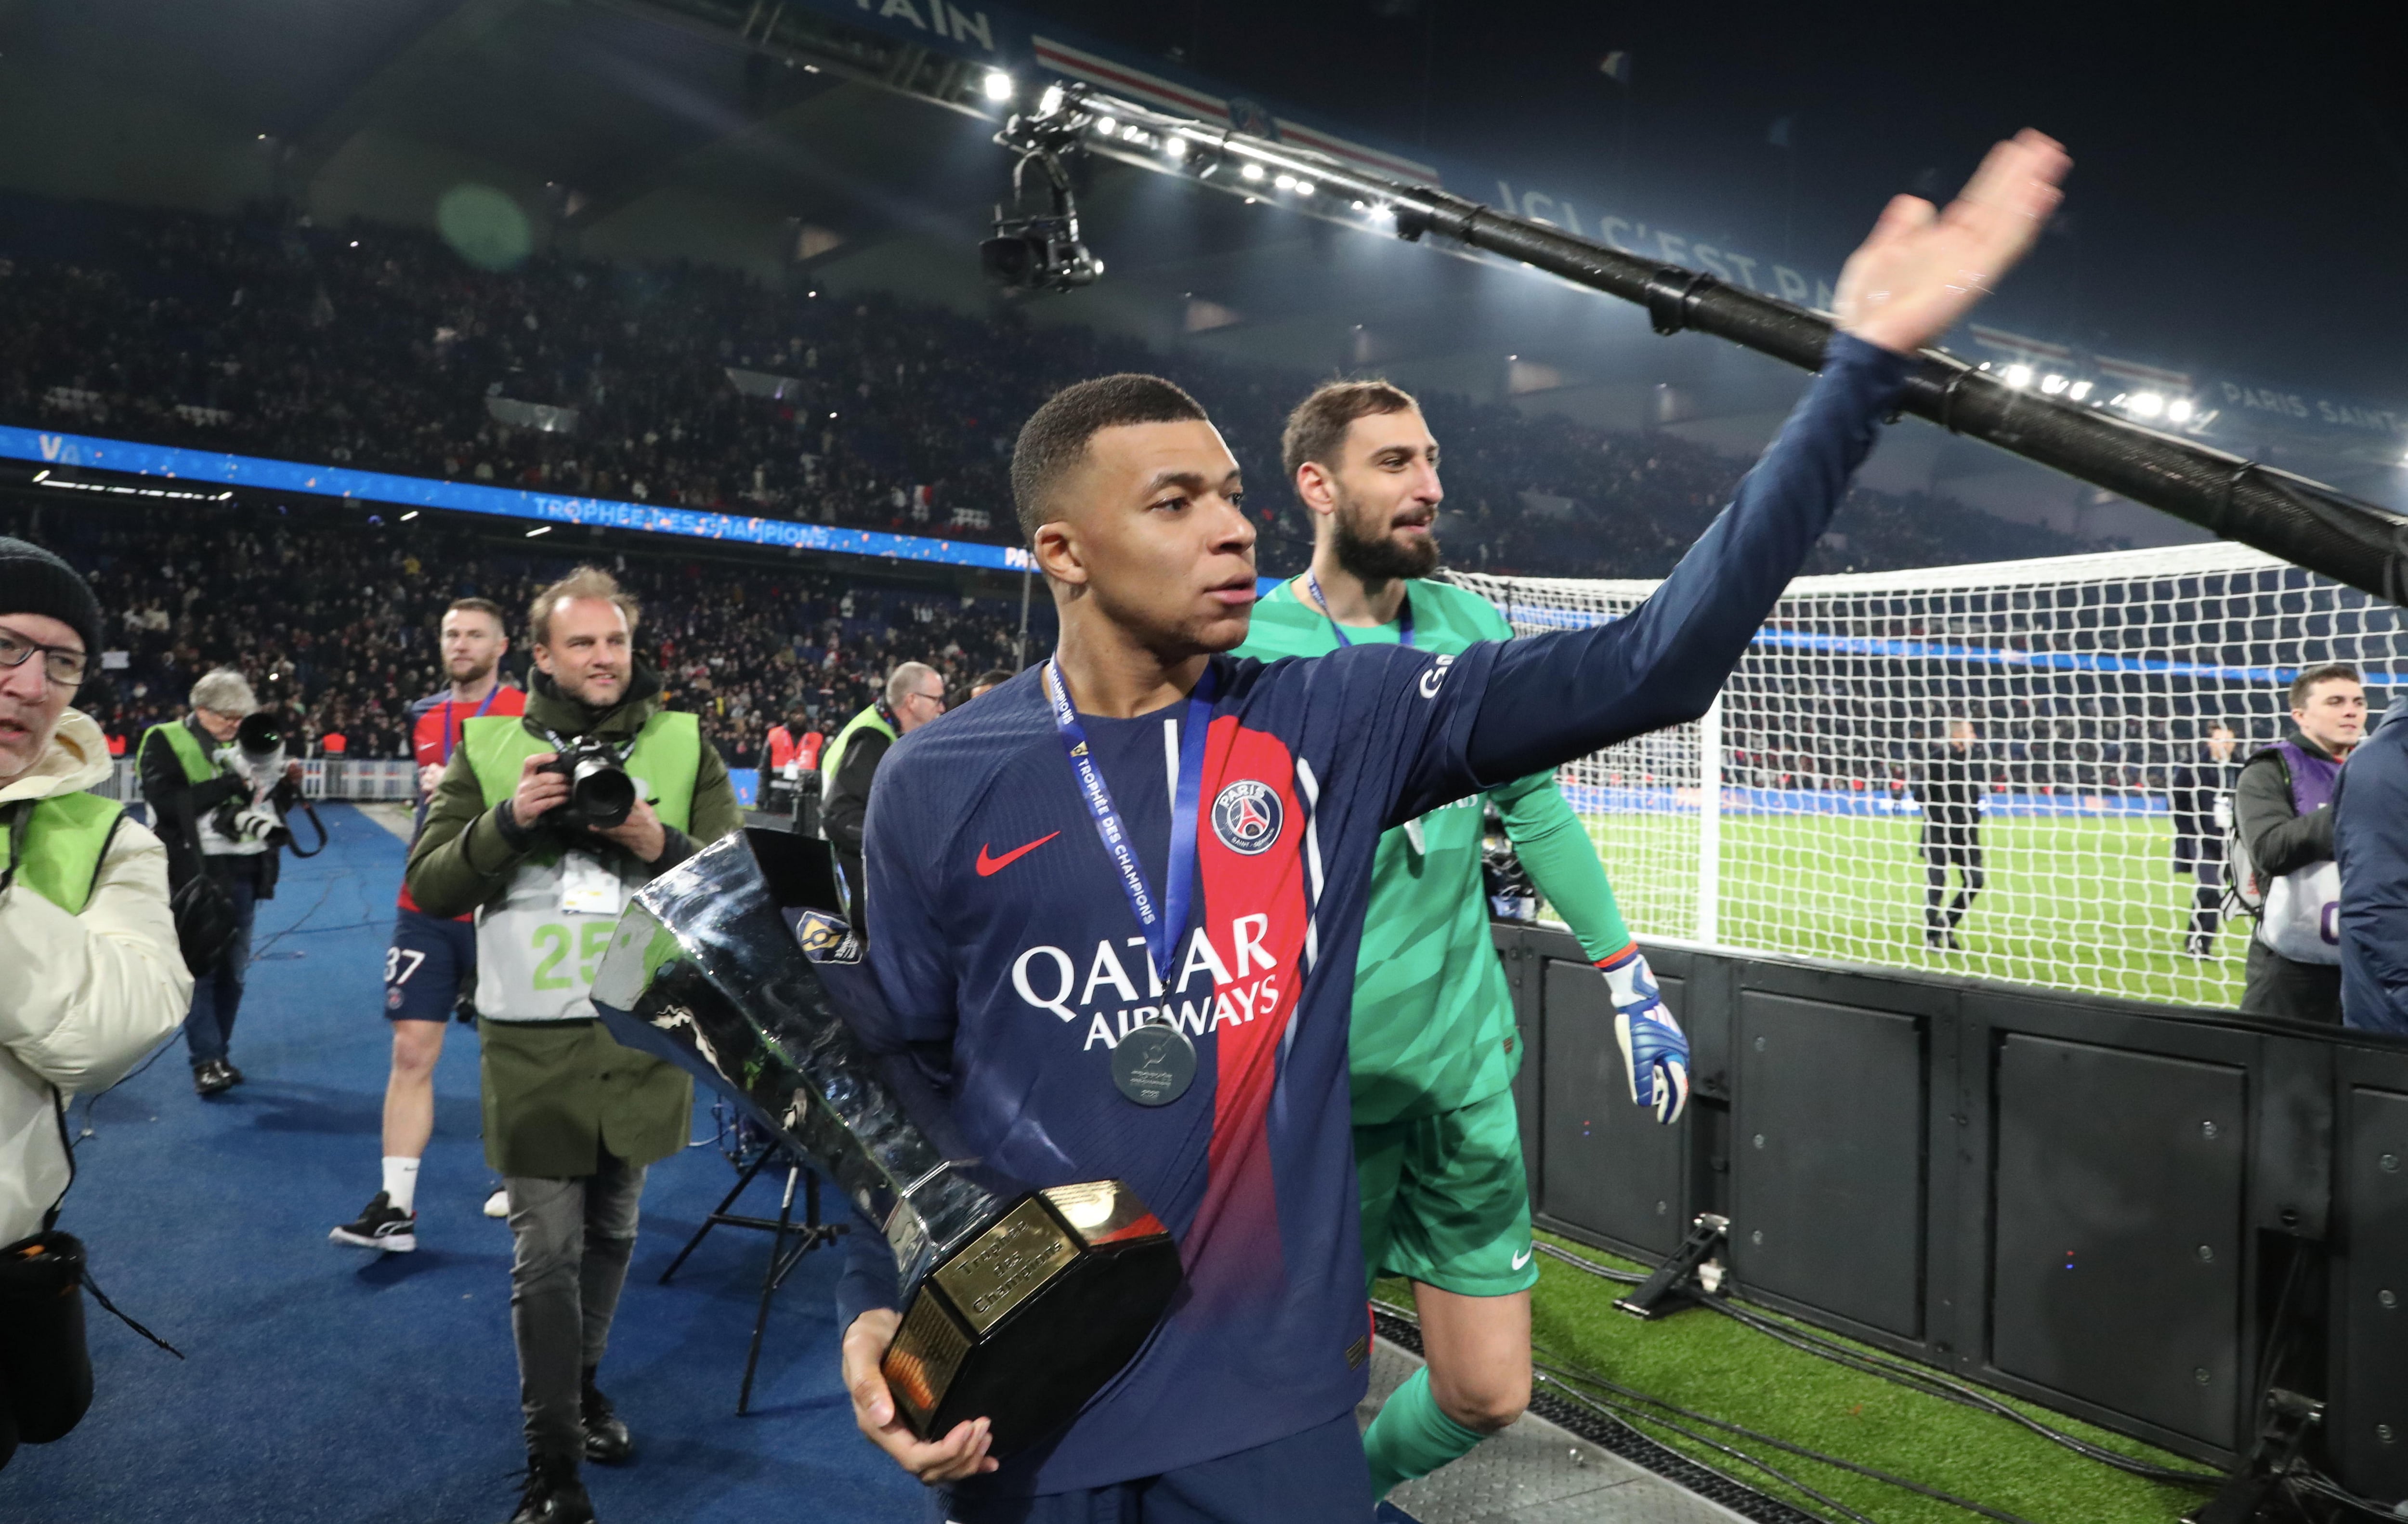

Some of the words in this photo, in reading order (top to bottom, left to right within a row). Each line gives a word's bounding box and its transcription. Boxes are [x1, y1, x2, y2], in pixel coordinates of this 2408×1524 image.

[2221, 381, 2309, 418] PARIS
[533, 497, 644, 527] TROPHÉE
[651, 507, 695, 532] DES
[702, 516, 829, 547] CHAMPIONS
[1051, 668, 1074, 725] CHAMPIONS
[1218, 785, 1267, 809] PARIS
[1077, 758, 1110, 816] TROPHÉE
[1101, 816, 1122, 844] DES
[1114, 844, 1155, 925] CHAMPIONS
[384, 946, 425, 985] 37
[532, 920, 618, 991] 25
[1011, 913, 1278, 1023] QATAR
[955, 1220, 1029, 1276] Trophée
[993, 1250, 1023, 1279] des
[973, 1240, 1064, 1314] Champions
